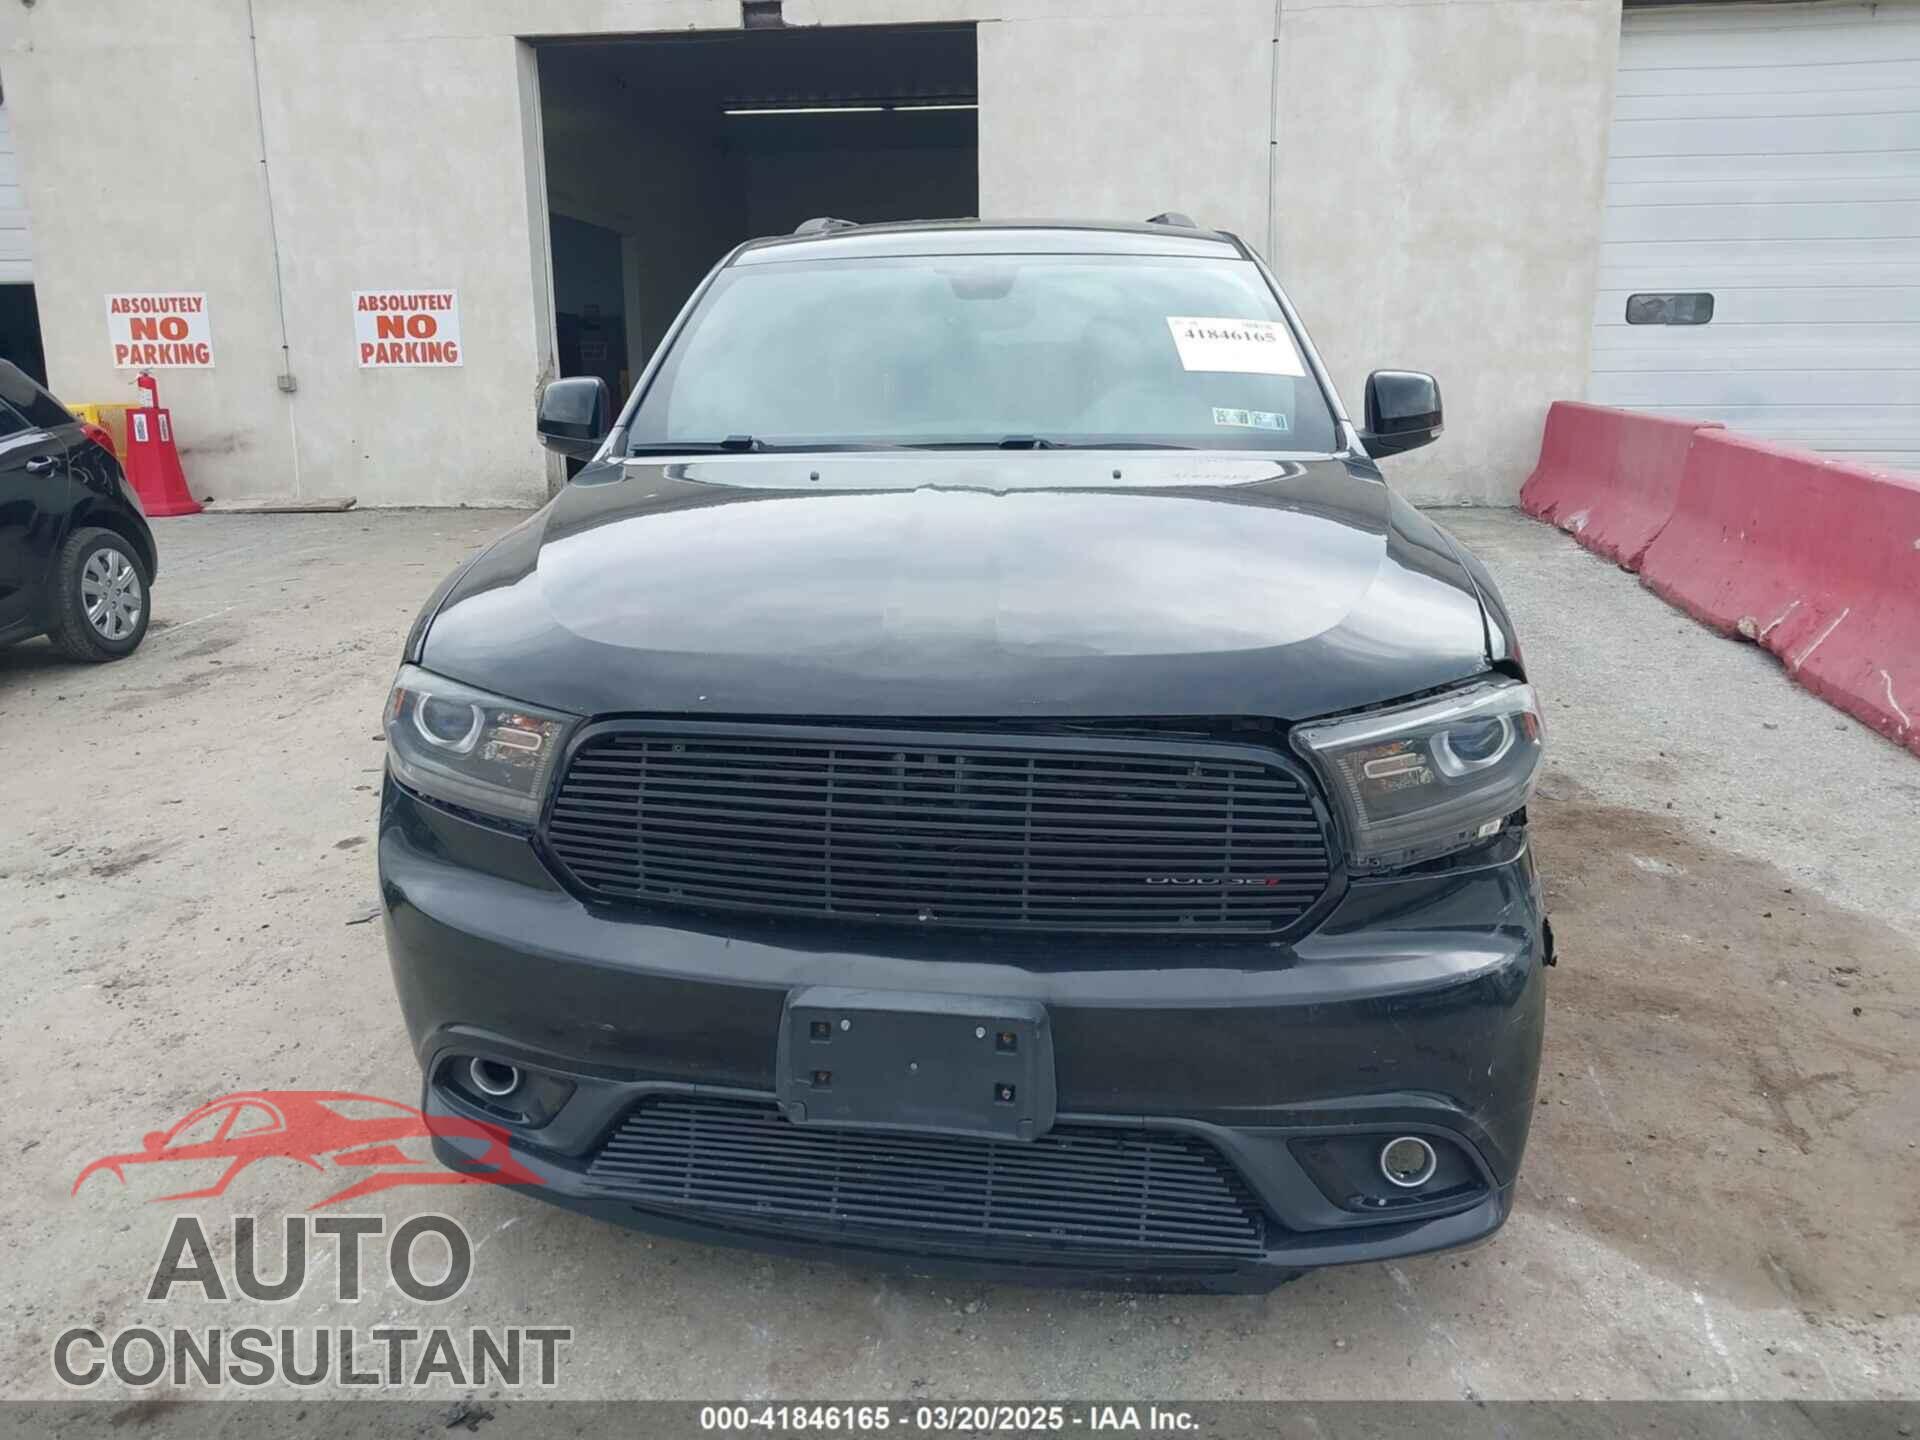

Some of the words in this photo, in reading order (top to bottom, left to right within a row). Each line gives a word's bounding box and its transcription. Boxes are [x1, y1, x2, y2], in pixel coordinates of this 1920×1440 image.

[111, 297, 202, 313] ABSOLUTELY
[357, 294, 453, 311] ABSOLUTELY
[129, 316, 189, 341] NO
[376, 314, 438, 339] NO
[1184, 328, 1277, 343] 41846165
[115, 343, 210, 365] PARKING
[360, 341, 458, 364] PARKING
